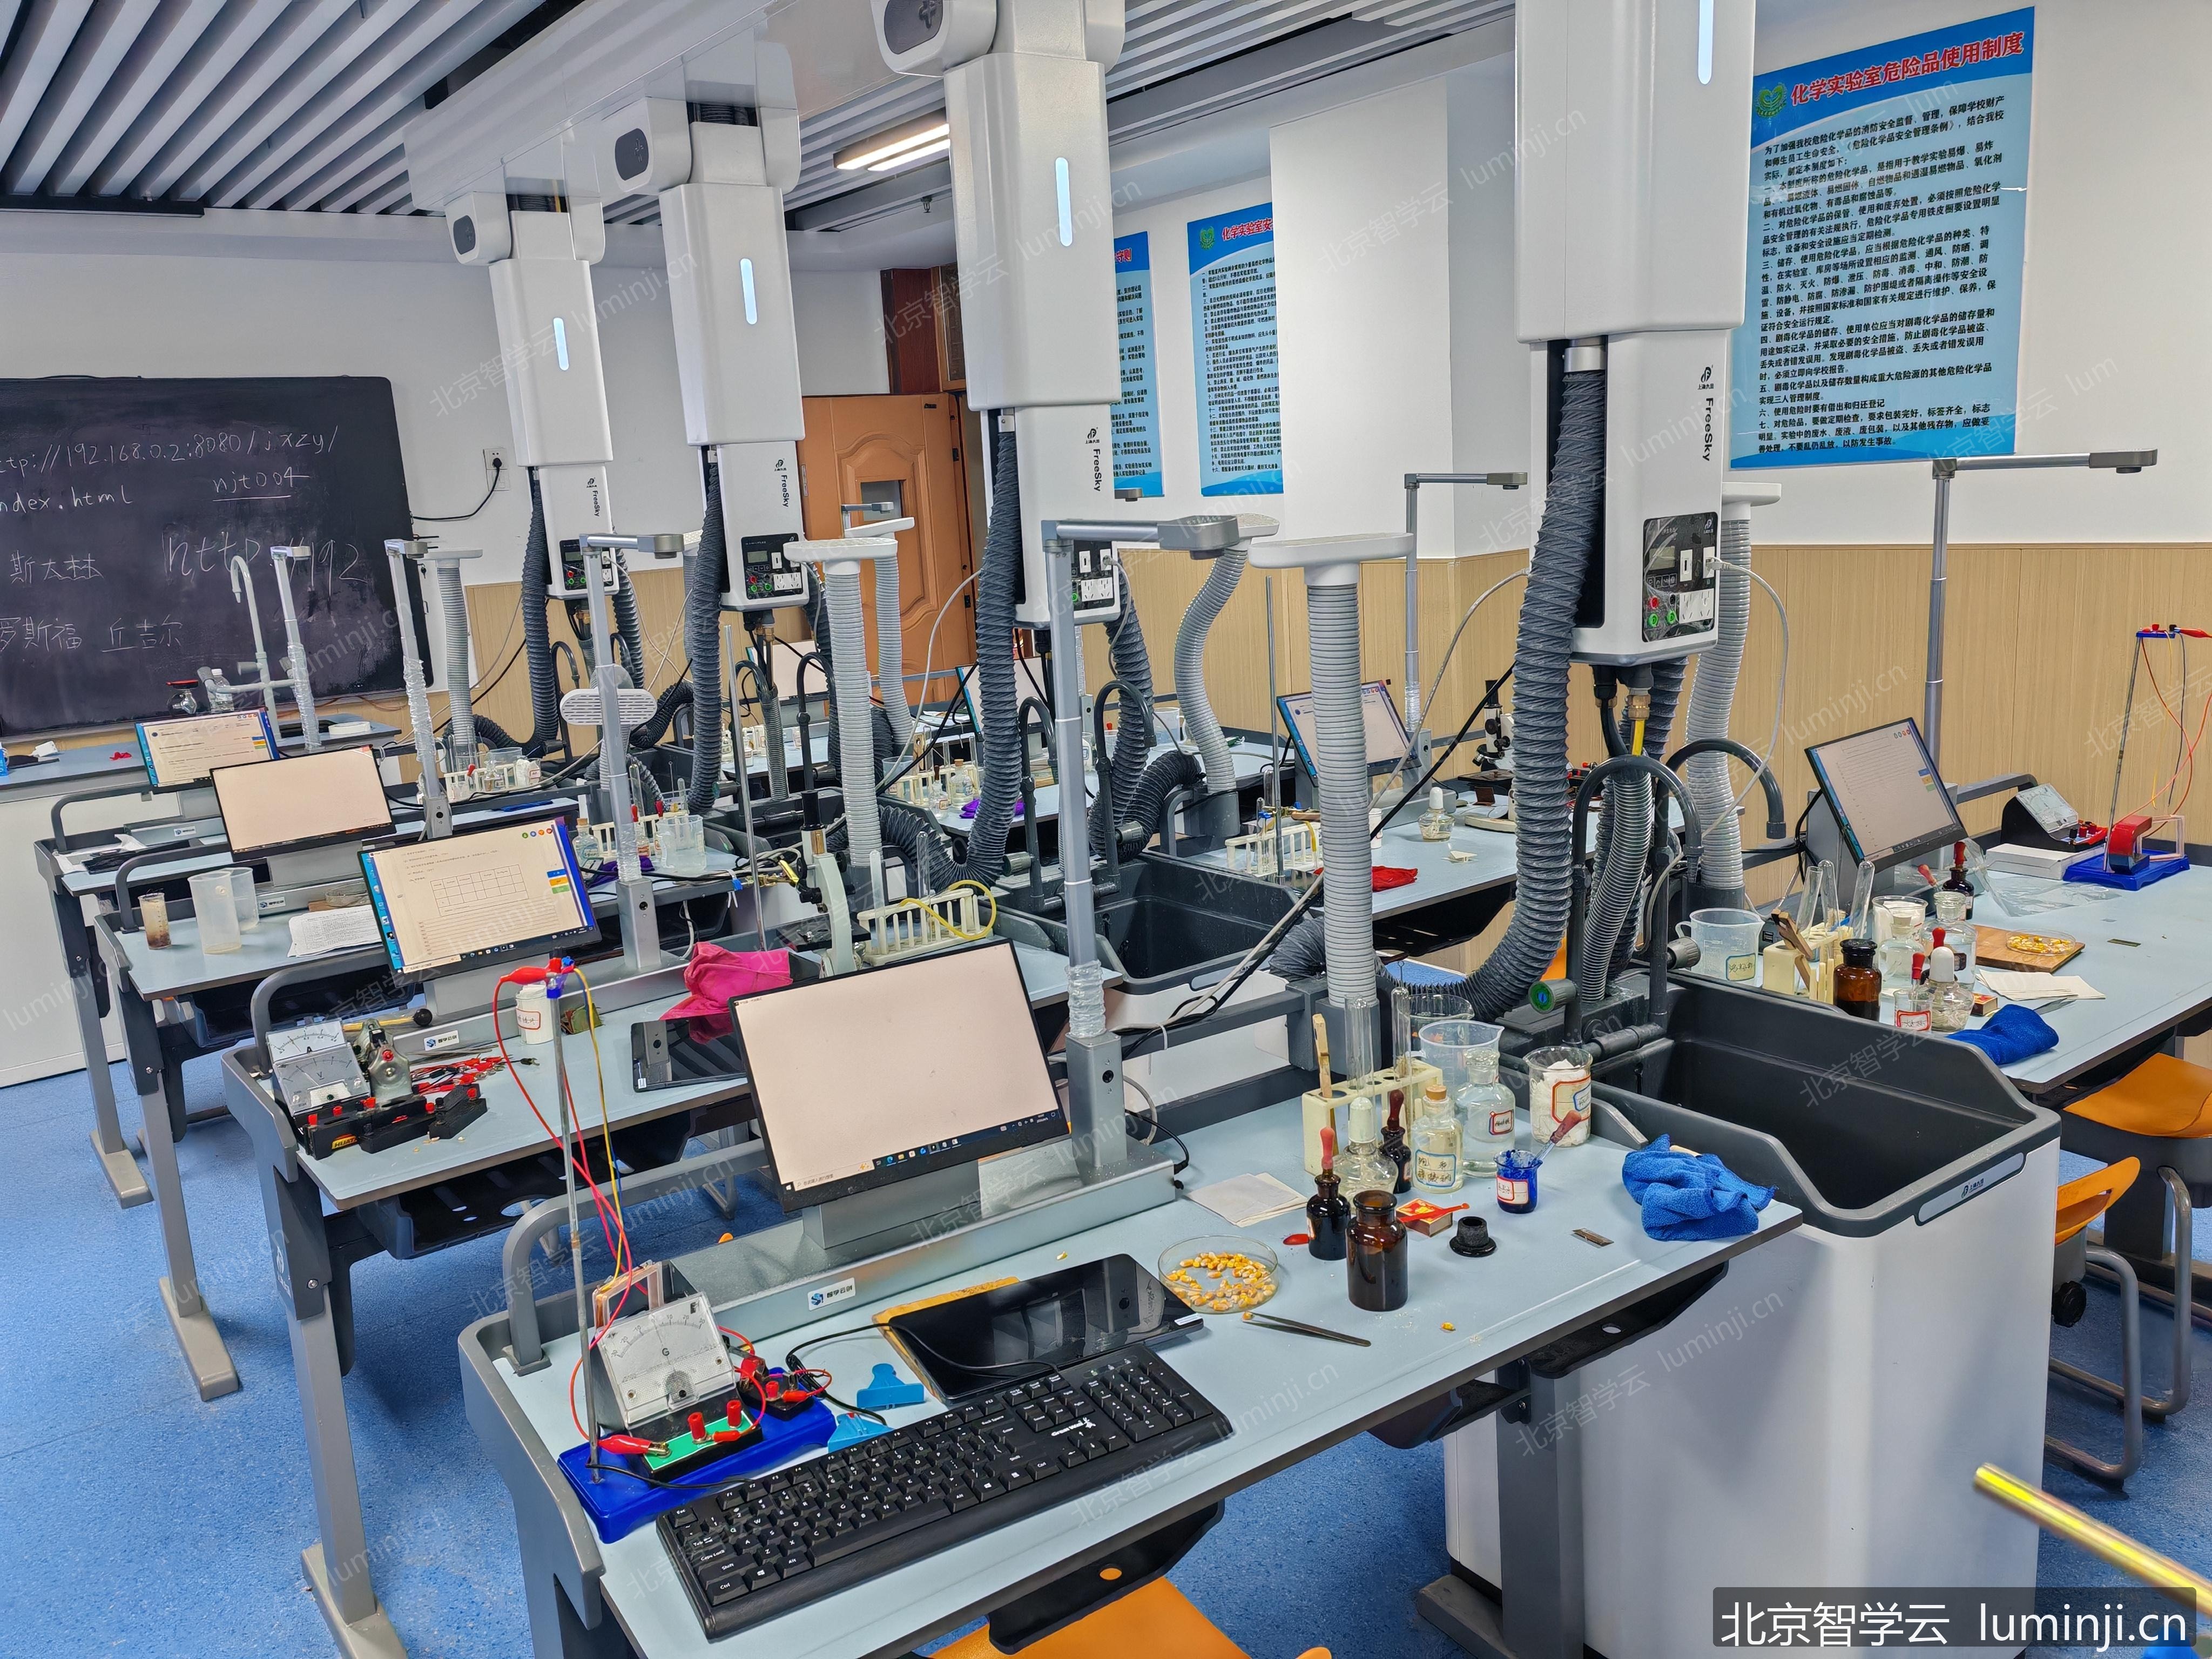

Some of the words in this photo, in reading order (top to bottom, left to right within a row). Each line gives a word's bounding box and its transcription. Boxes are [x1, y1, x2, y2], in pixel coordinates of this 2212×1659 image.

[1791, 31, 2024, 106] 化学实验室危险品使用制度
[1222, 218, 1273, 241] 化学实验室安
[1702, 397, 1714, 461] FreeSky
[1093, 449, 1102, 492] FreeSky
[781, 475, 790, 507] FreeSky
[826, 1285, 853, 1298] 智学云创
[662, 1347, 670, 1357] G
